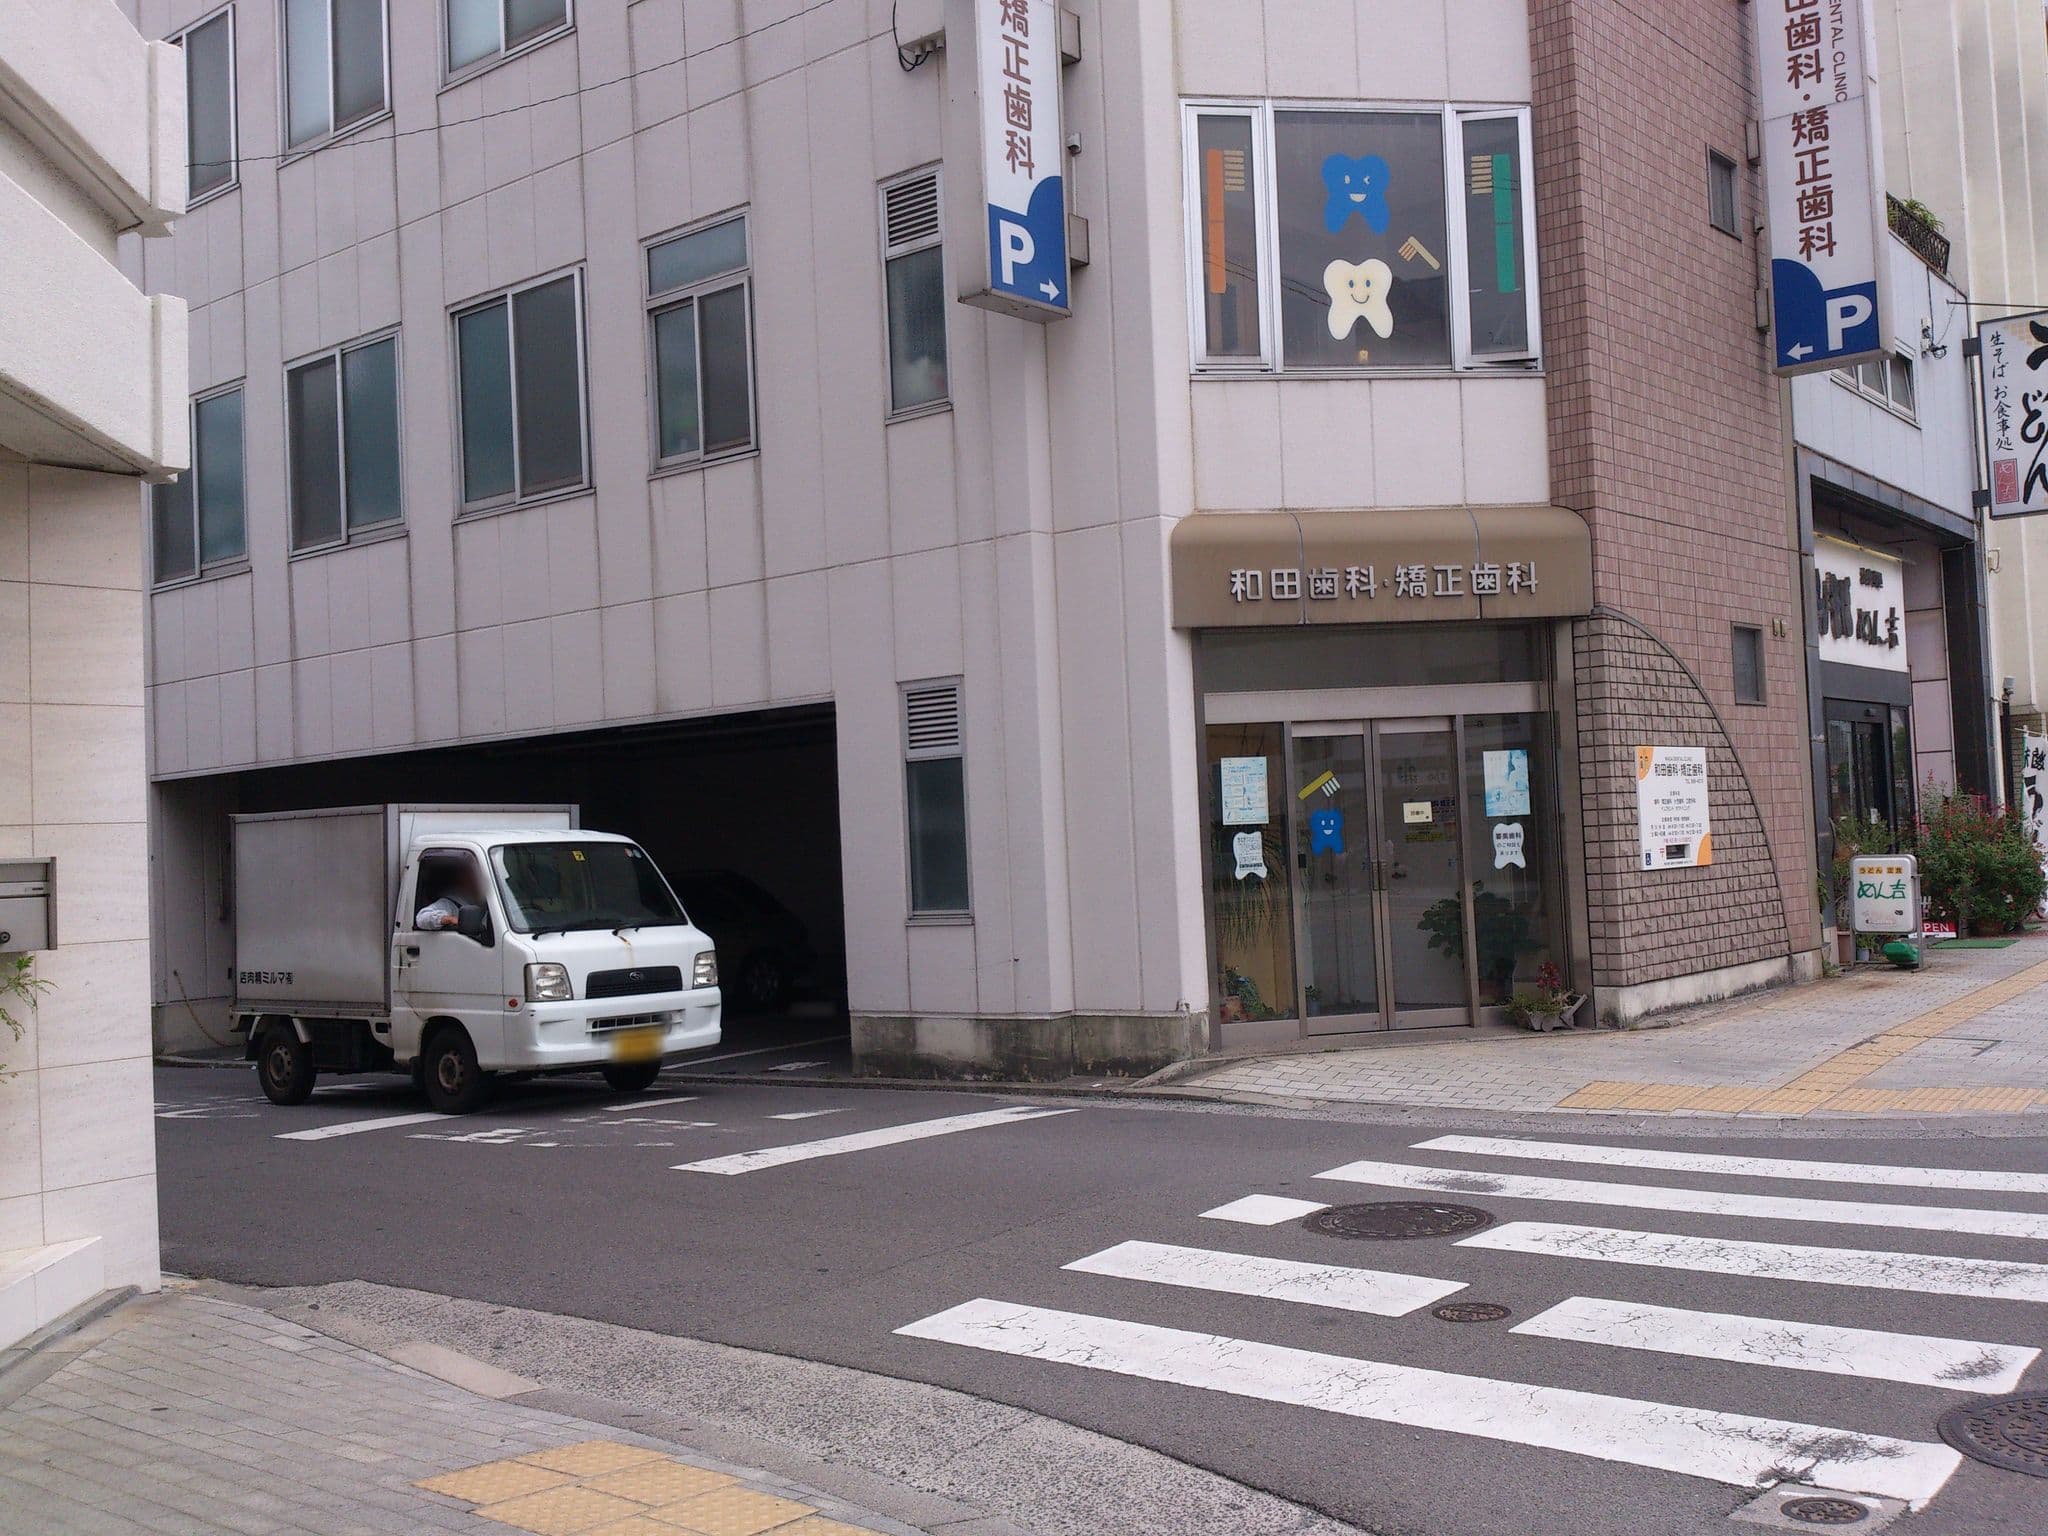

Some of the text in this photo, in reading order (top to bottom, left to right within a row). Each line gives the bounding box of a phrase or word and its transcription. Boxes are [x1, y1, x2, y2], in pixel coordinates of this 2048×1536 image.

[1832, 51, 1848, 103] CLINIC
[998, 219, 1035, 285] P
[1825, 293, 1873, 352] P
[1857, 879, 1907, 900] めん吉
[1922, 922, 1949, 932] PEN
